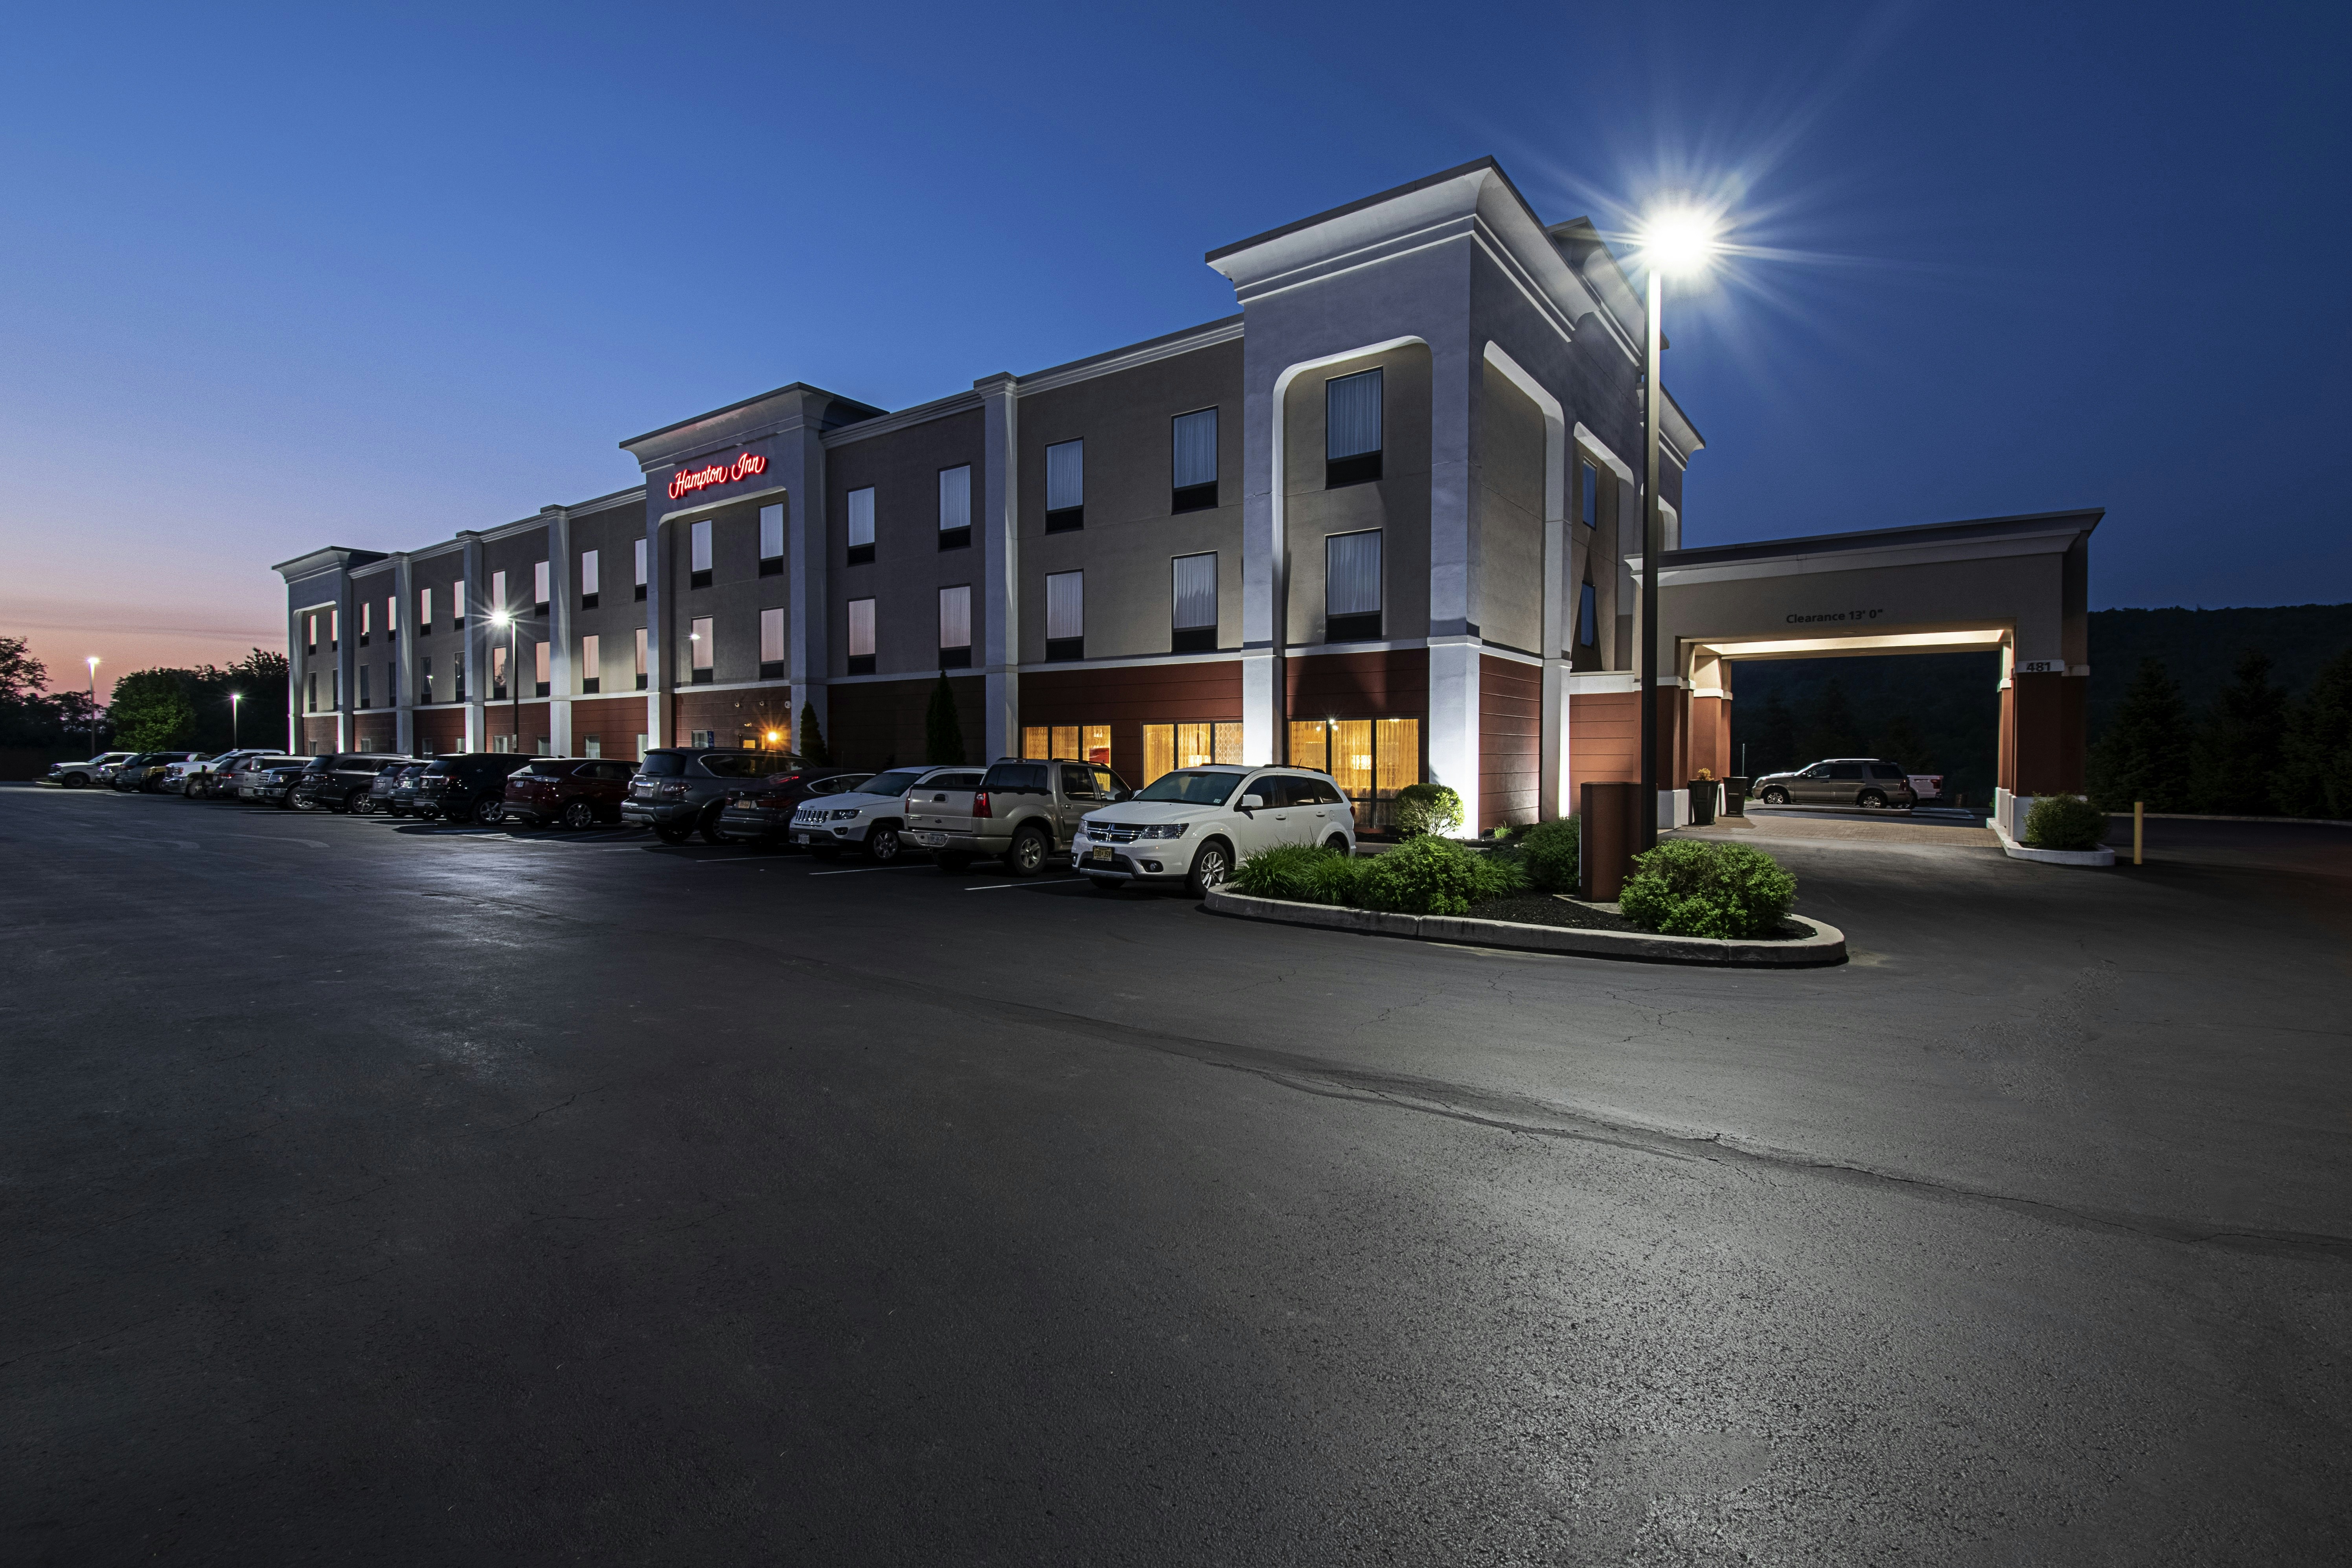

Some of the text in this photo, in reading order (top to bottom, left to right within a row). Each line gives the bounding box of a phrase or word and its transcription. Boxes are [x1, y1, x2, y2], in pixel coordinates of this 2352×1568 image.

[669, 453, 765, 499] Hampton Inn
[1786, 609, 1883, 623] Clearance 13' 0"
[2026, 662, 2050, 672] 481
